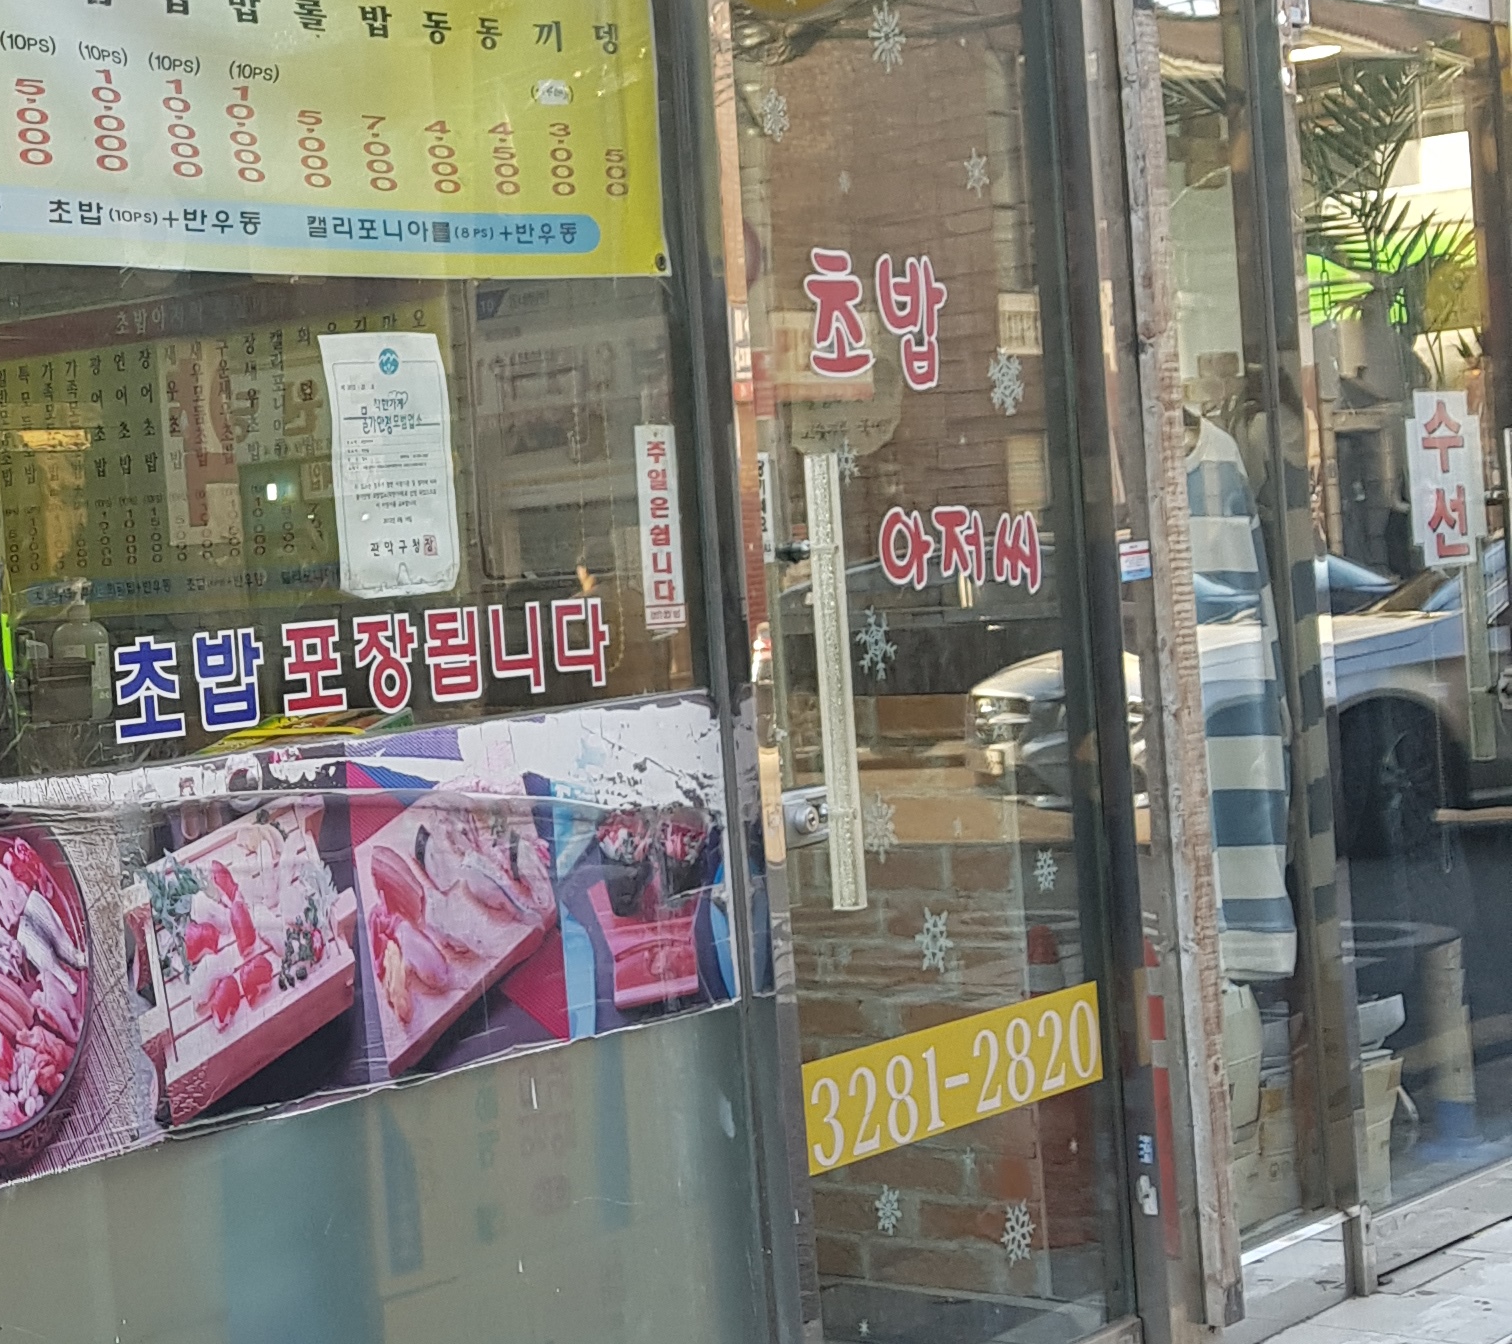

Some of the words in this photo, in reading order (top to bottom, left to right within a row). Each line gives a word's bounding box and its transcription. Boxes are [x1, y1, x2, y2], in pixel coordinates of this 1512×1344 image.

[0, 30, 57, 55] (10PS)
[78, 41, 128, 67] (10PS)
[148, 52, 201, 76] (10PS)
[228, 60, 280, 84] (10PS)
[804, 247, 948, 391] 초밥
[1421, 398, 1472, 559] 수선
[878, 506, 1042, 596] 아저씨
[114, 624, 265, 746] 초밥
[281, 596, 611, 719] 포장됩니다
[809, 998, 1103, 1170] 3281-2820
